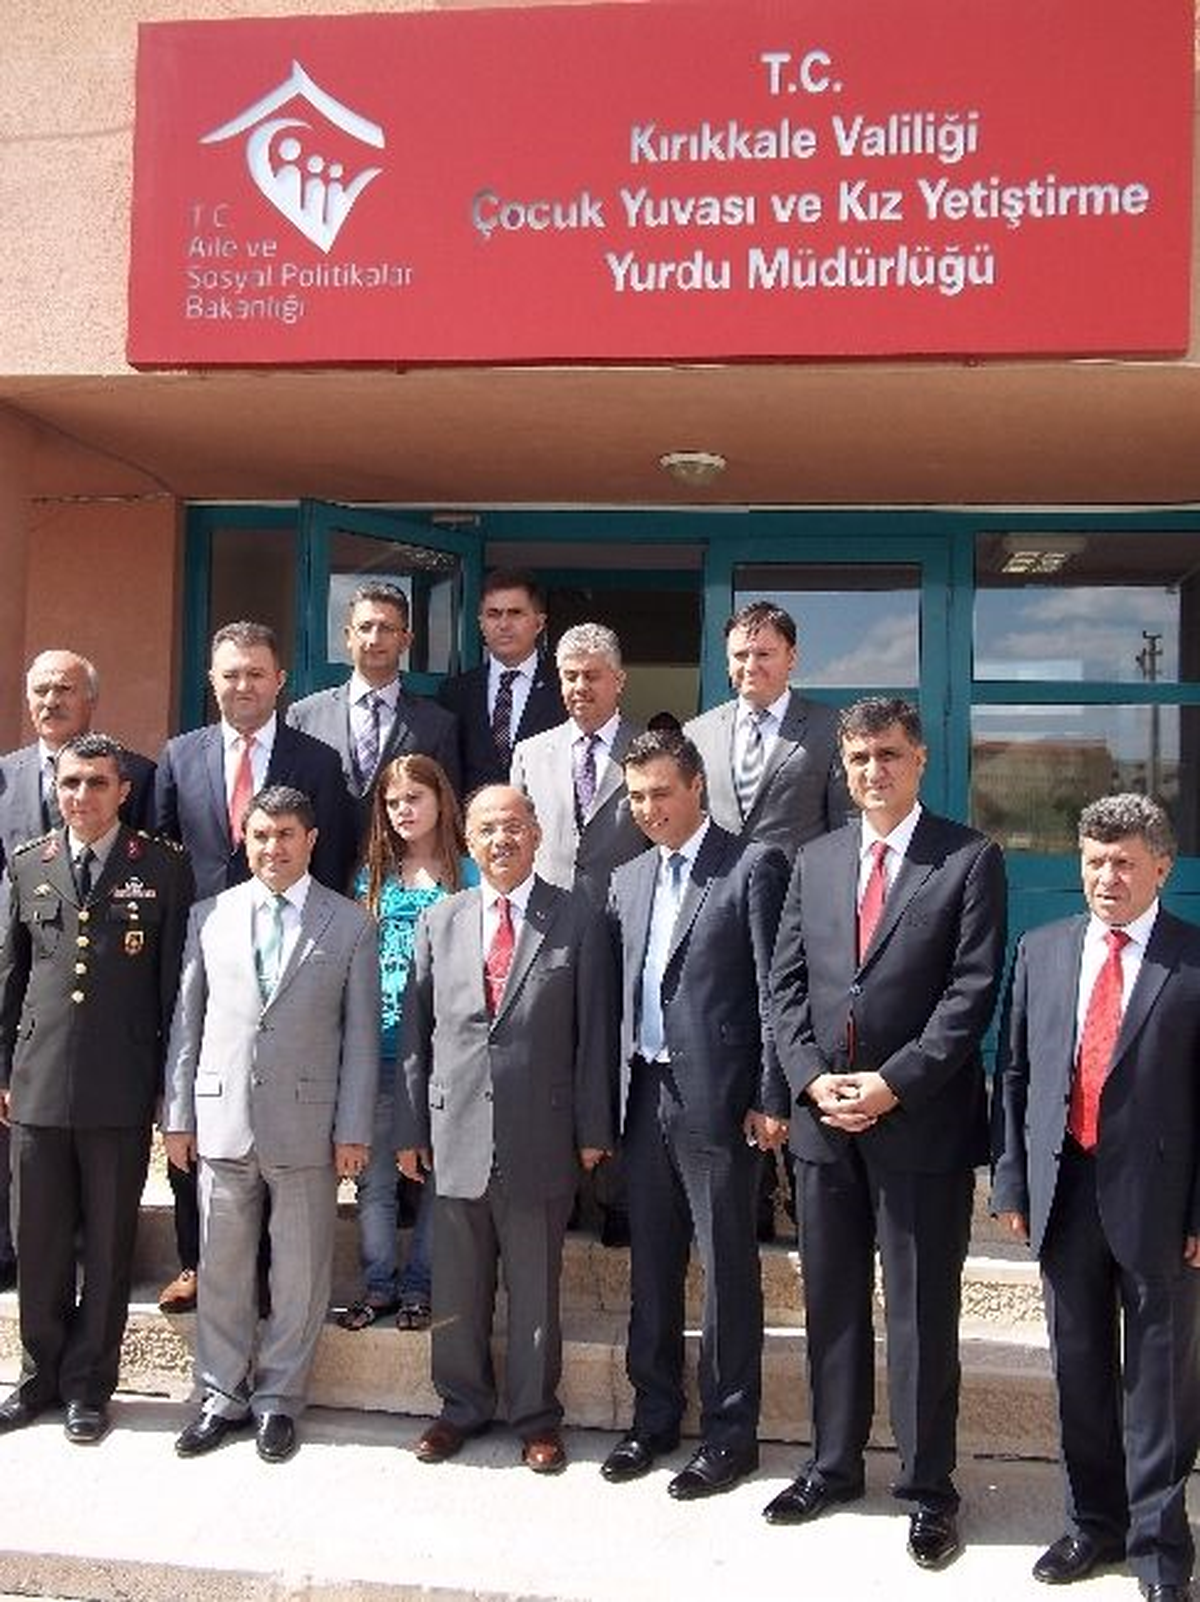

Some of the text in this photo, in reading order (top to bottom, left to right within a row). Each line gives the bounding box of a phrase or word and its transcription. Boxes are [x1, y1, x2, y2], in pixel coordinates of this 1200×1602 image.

[760, 50, 844, 95] T.C.
[629, 111, 980, 164] Kırıkkale Valiliği
[471, 175, 1151, 239] Çocuk Yuvası ve Kız Yetiştirme
[247, 238, 278, 258] ve
[605, 243, 996, 297] Yurdu Müdürlüğü
[186, 261, 413, 294] Sosyal Politikalar
[186, 294, 305, 325] Bakanlığı
